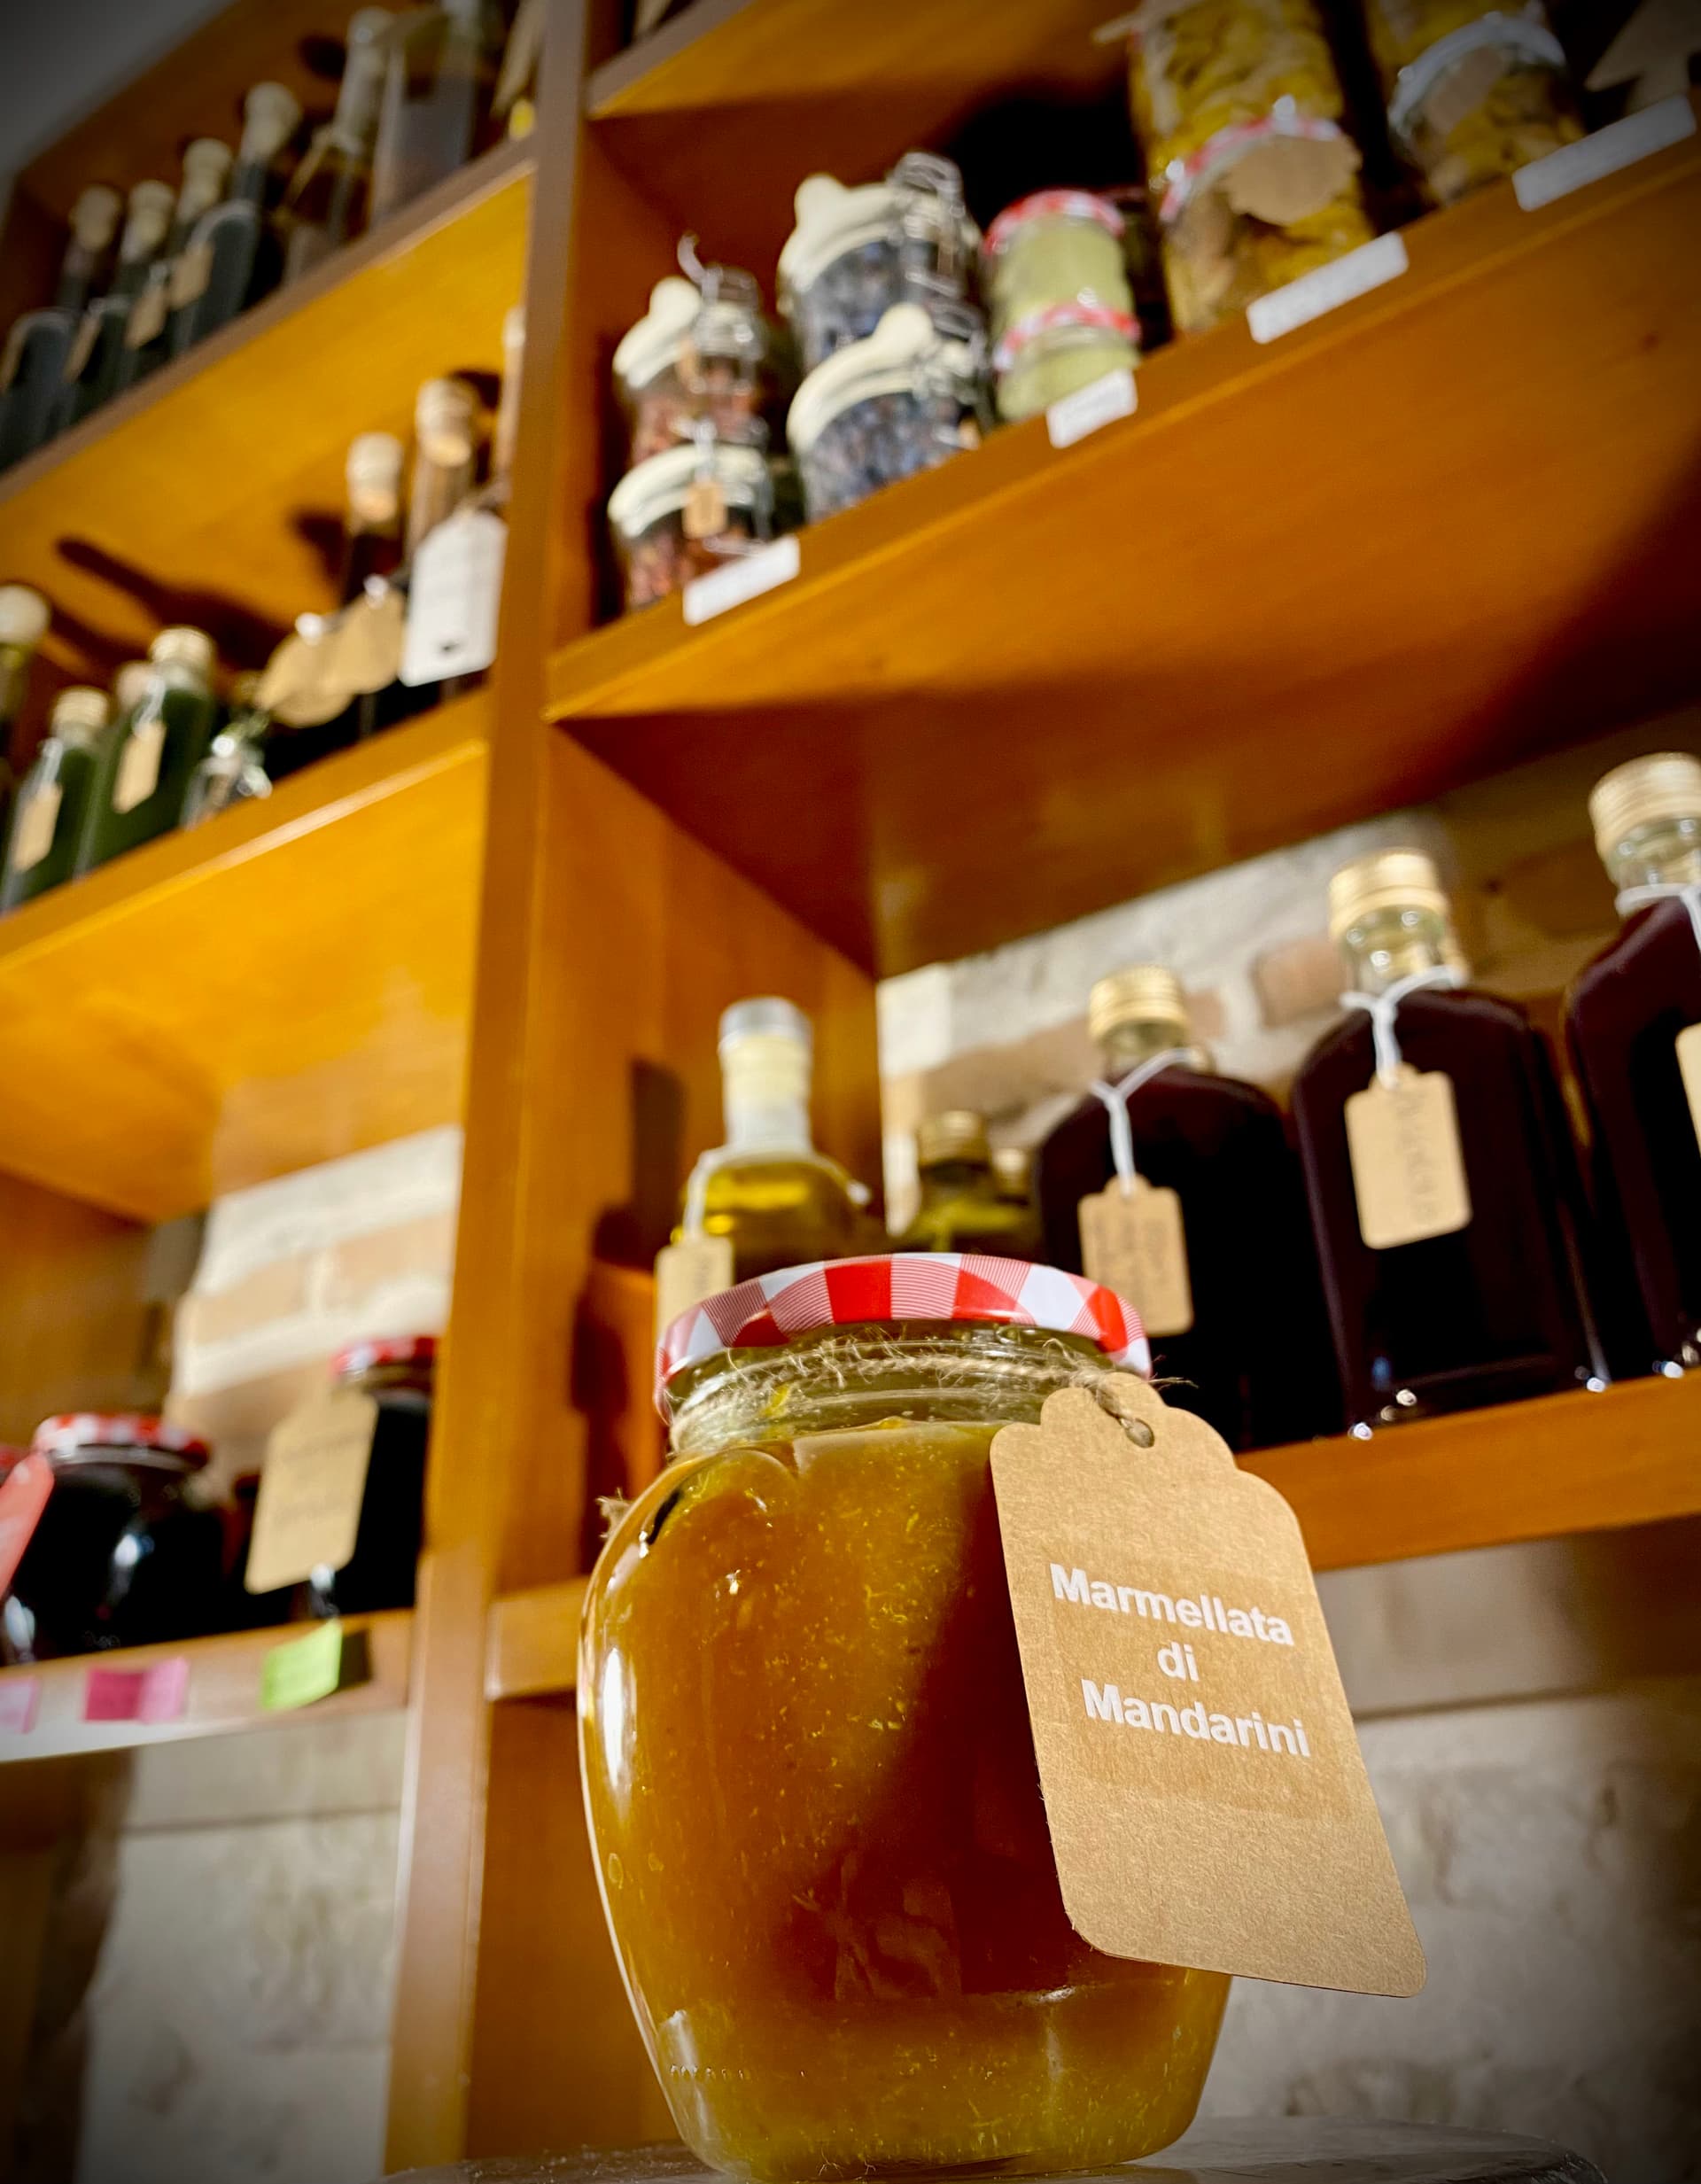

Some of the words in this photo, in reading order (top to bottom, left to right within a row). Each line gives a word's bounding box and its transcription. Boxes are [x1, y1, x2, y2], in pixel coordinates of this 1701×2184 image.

[1050, 1564, 1294, 1645] Marmellata
[1158, 1642, 1200, 1682] di
[1081, 1679, 1310, 1757] Mandarini
